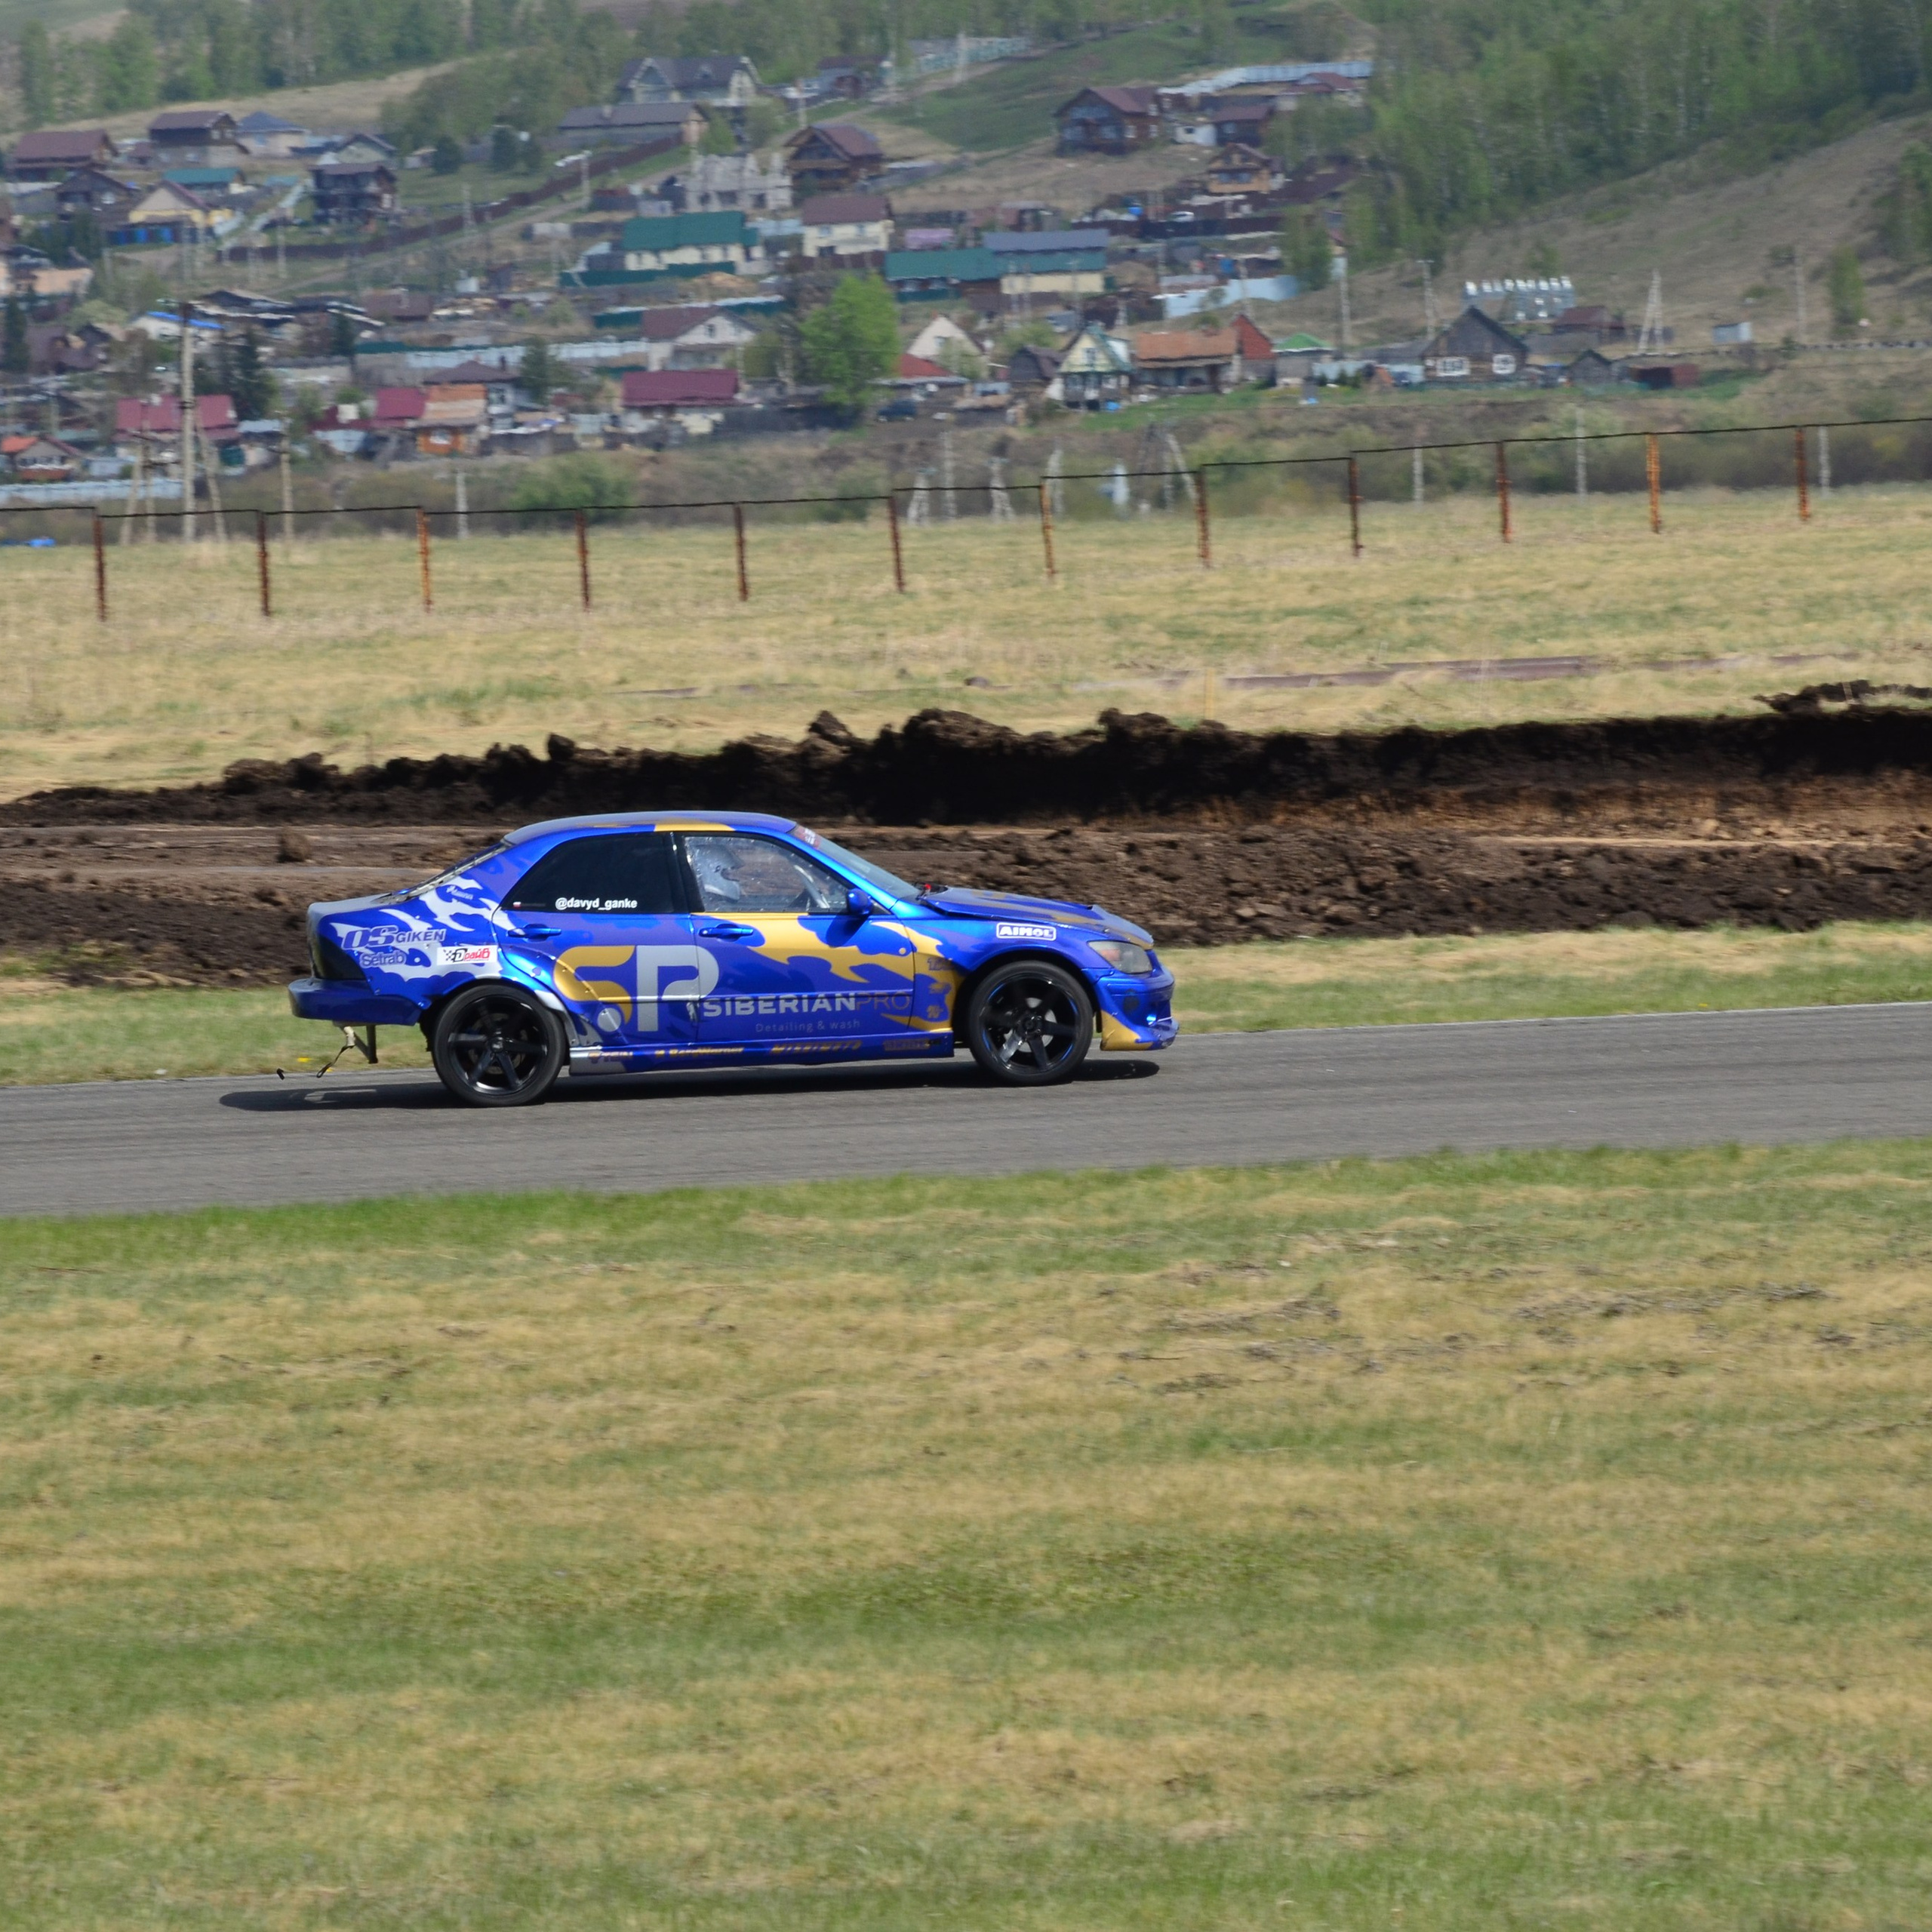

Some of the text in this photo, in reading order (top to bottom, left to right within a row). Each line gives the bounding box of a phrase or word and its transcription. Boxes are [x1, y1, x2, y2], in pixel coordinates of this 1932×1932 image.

[555, 897, 638, 910] @davyd_ganke
[395, 929, 446, 943] GIKEN
[998, 926, 1054, 937] AIMOL
[360, 950, 407, 968] Setrab
[755, 1019, 860, 1033] Detailing & wash
